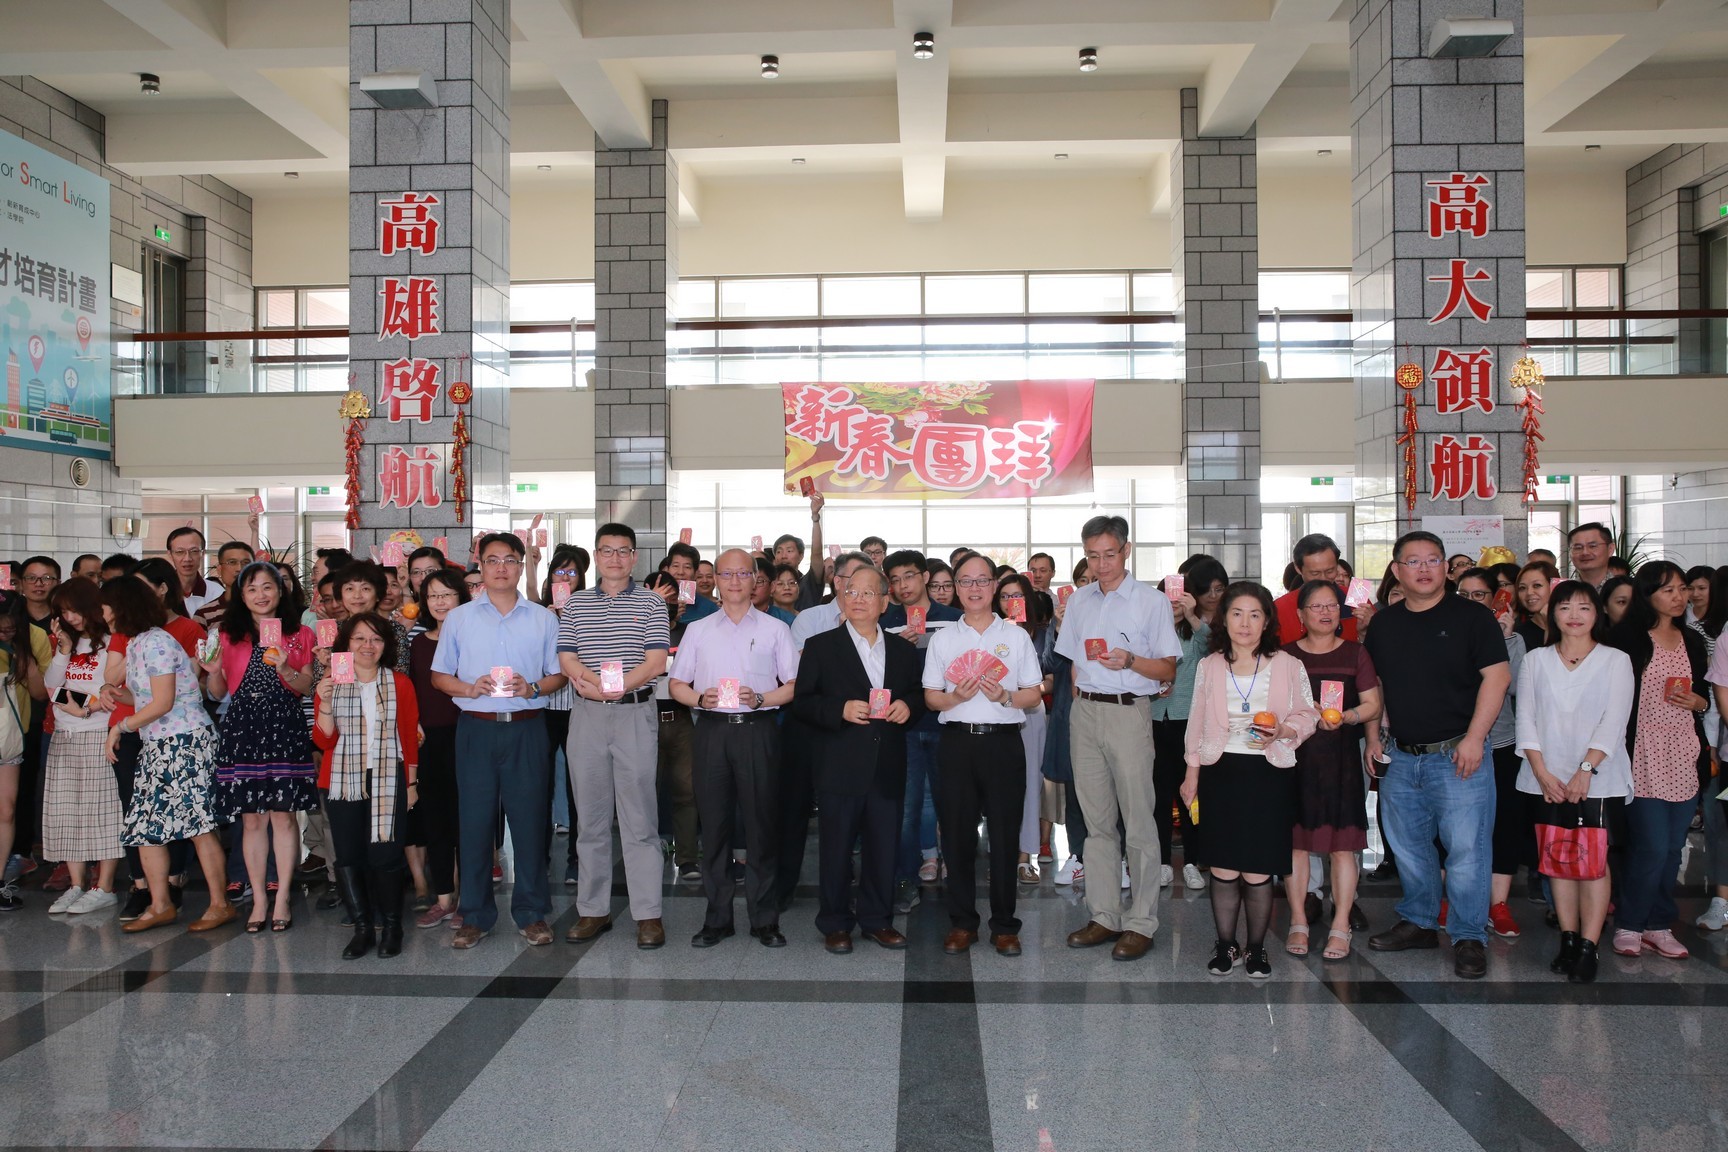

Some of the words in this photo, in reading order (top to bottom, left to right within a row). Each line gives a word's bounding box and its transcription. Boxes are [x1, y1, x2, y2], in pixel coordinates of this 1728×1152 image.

[0, 162, 14, 178] or
[20, 161, 59, 198] Smart
[63, 180, 96, 218] Living
[1426, 172, 1496, 502] 高大領航
[786, 384, 1052, 490] 新春團拜
[65, 670, 93, 681] Roots
